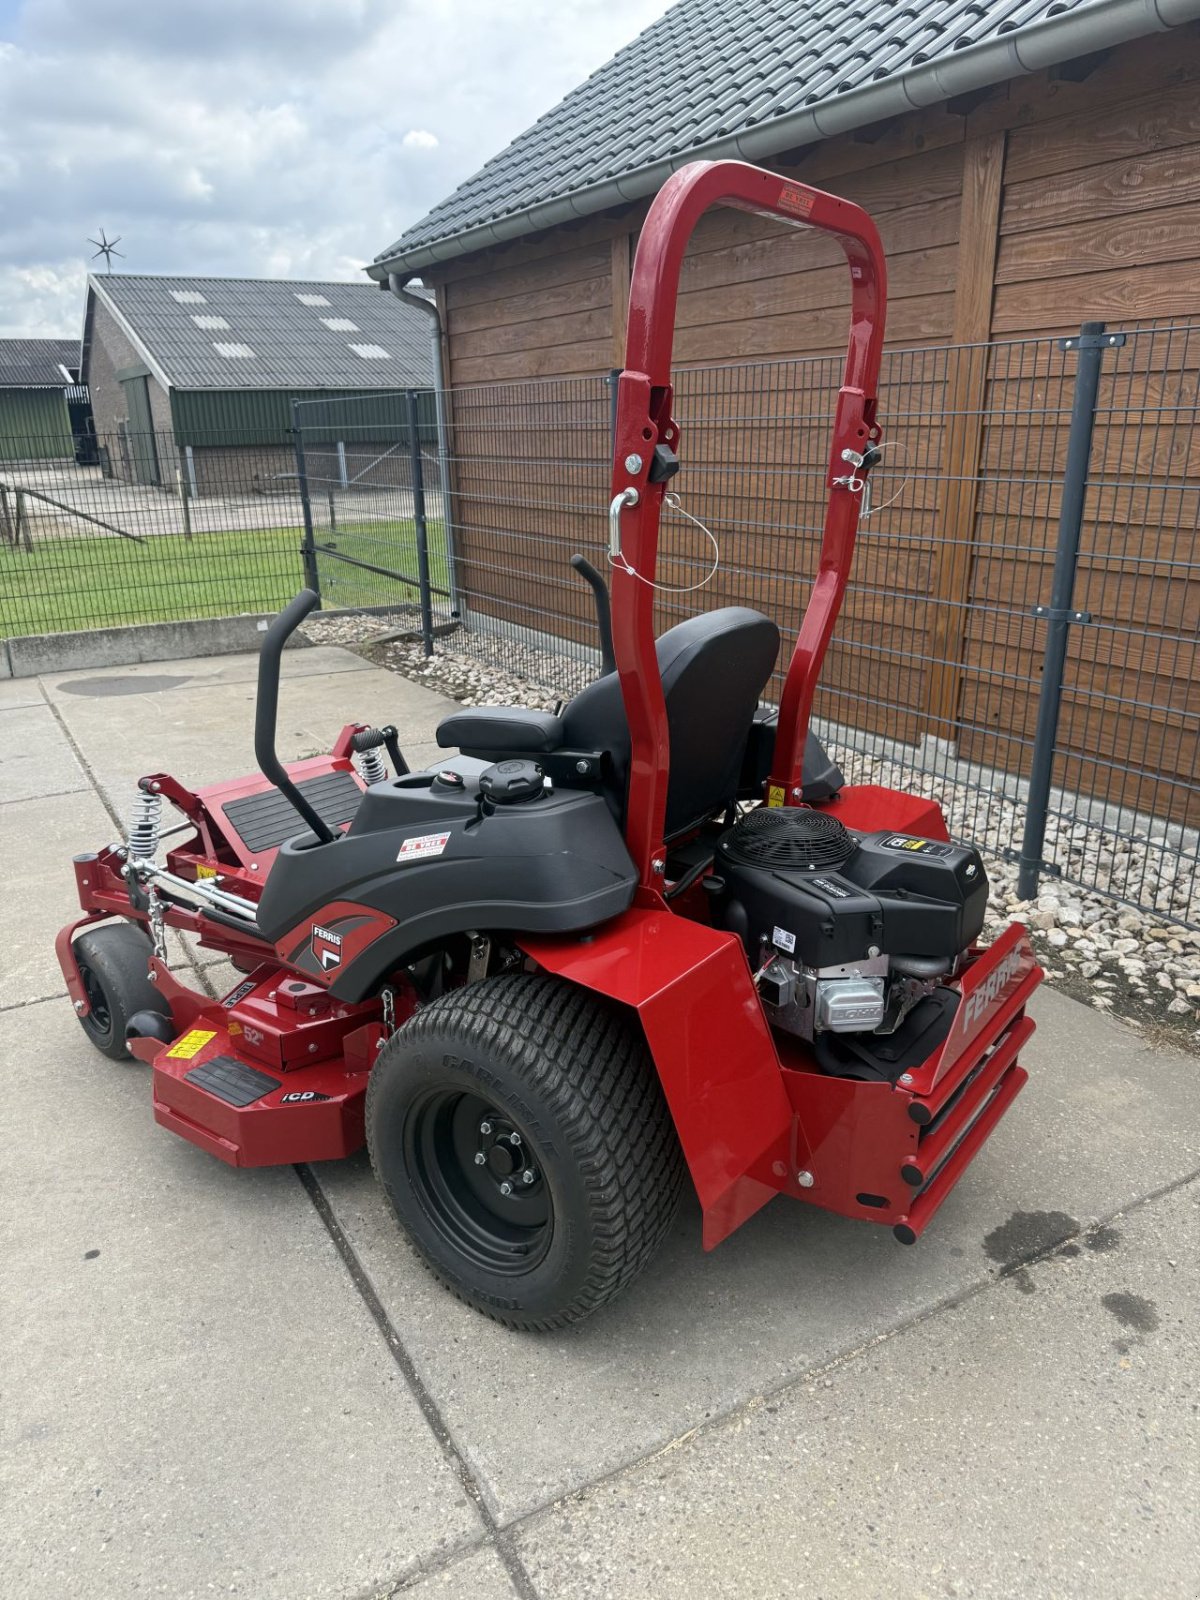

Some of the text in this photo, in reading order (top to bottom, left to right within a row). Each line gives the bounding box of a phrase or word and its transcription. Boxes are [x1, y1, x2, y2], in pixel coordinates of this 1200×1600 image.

[313, 926, 341, 946] FERRIS
[225, 984, 254, 1007] TRIPLE
[963, 942, 1022, 1034] FERRIS
[282, 1092, 315, 1102] iCD
